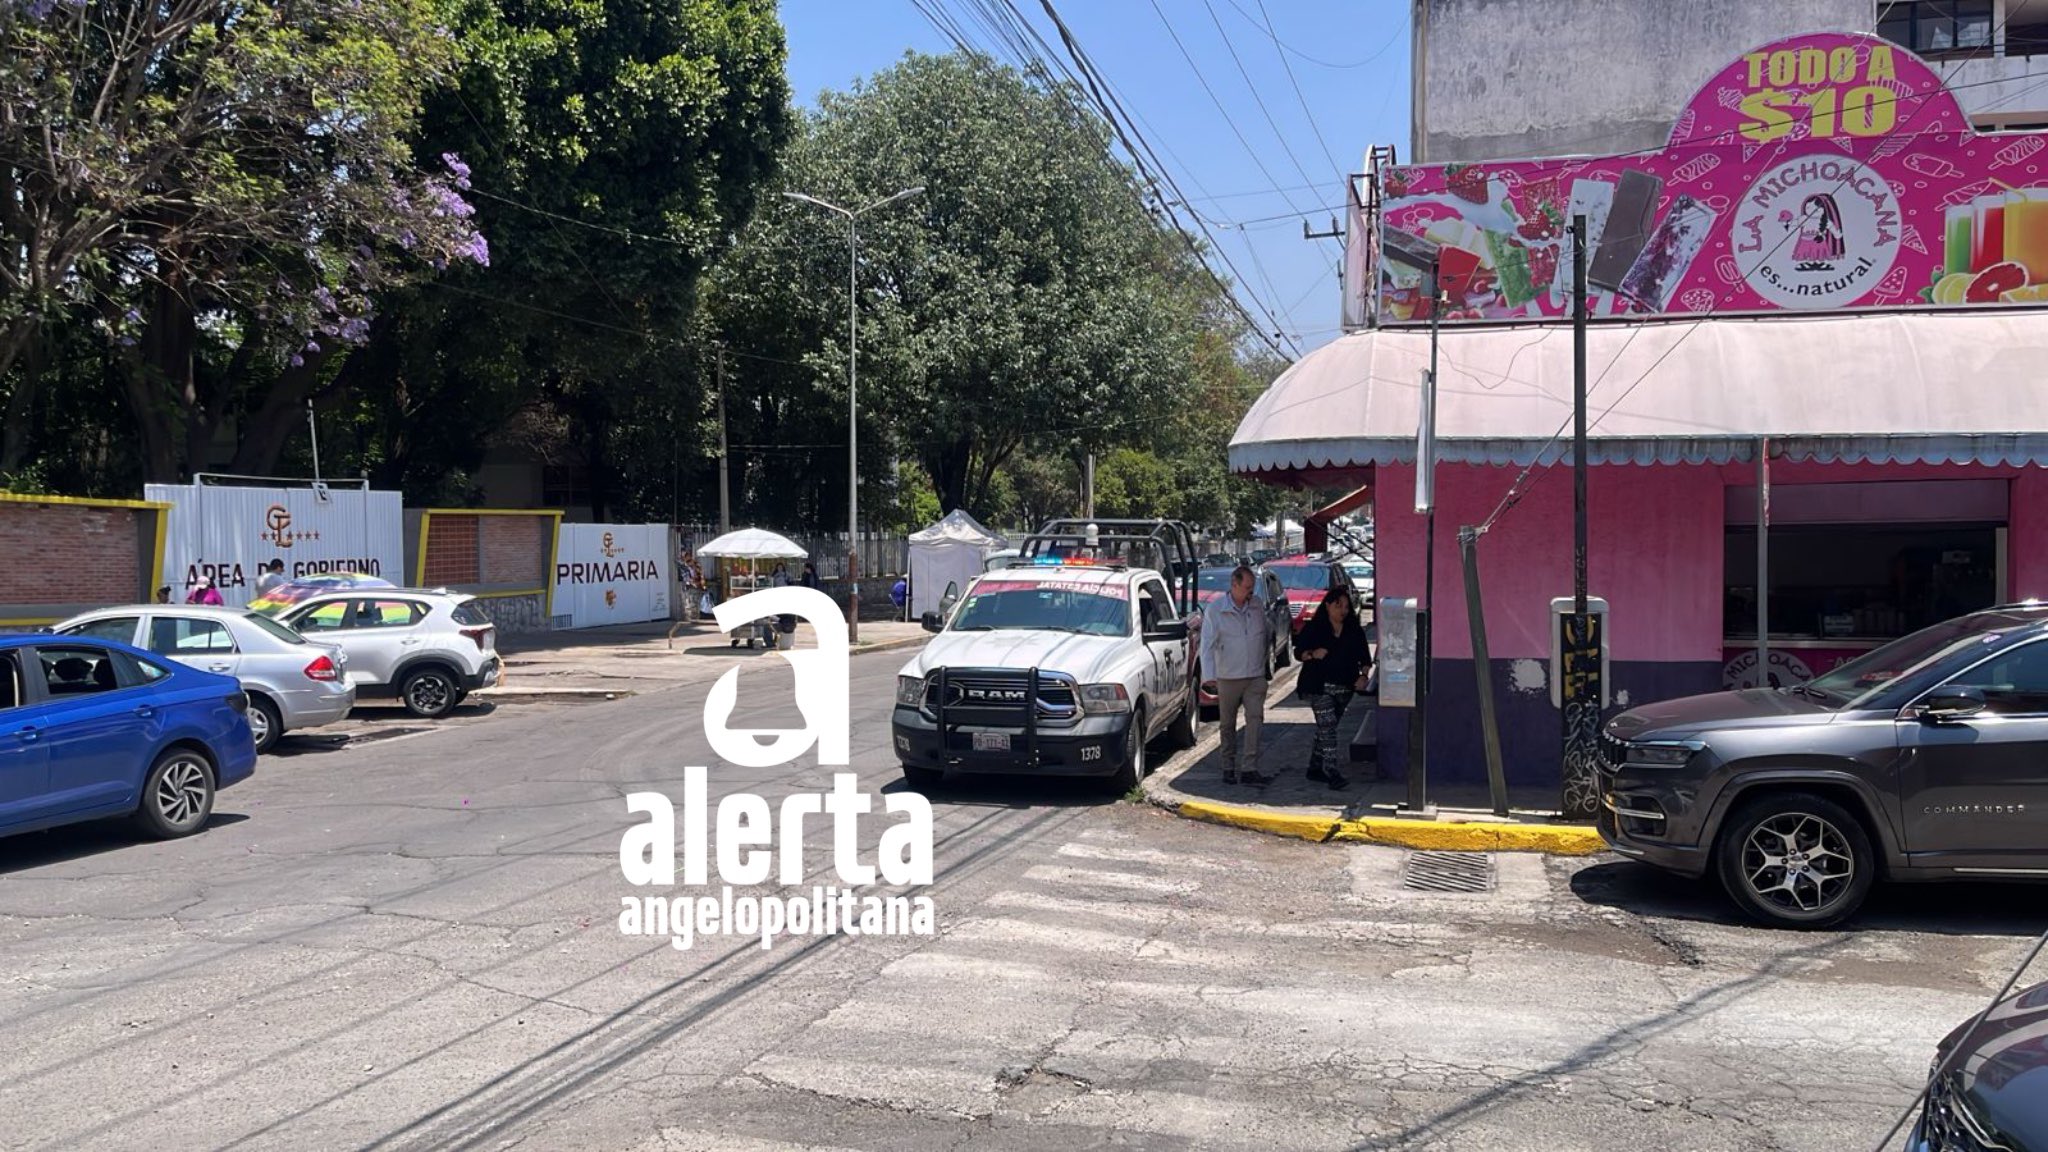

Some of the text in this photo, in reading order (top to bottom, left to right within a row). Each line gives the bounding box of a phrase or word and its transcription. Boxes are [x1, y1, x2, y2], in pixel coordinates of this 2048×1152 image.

[1743, 45, 1896, 88] TODO A
[1739, 86, 1897, 144] $10
[1738, 162, 1898, 253] LA MICHOACANA
[557, 560, 659, 586] PRIMARIA
[967, 689, 1026, 700] RAM
[1080, 745, 1102, 761] 1378
[1923, 804, 2025, 814] COMMANDER
